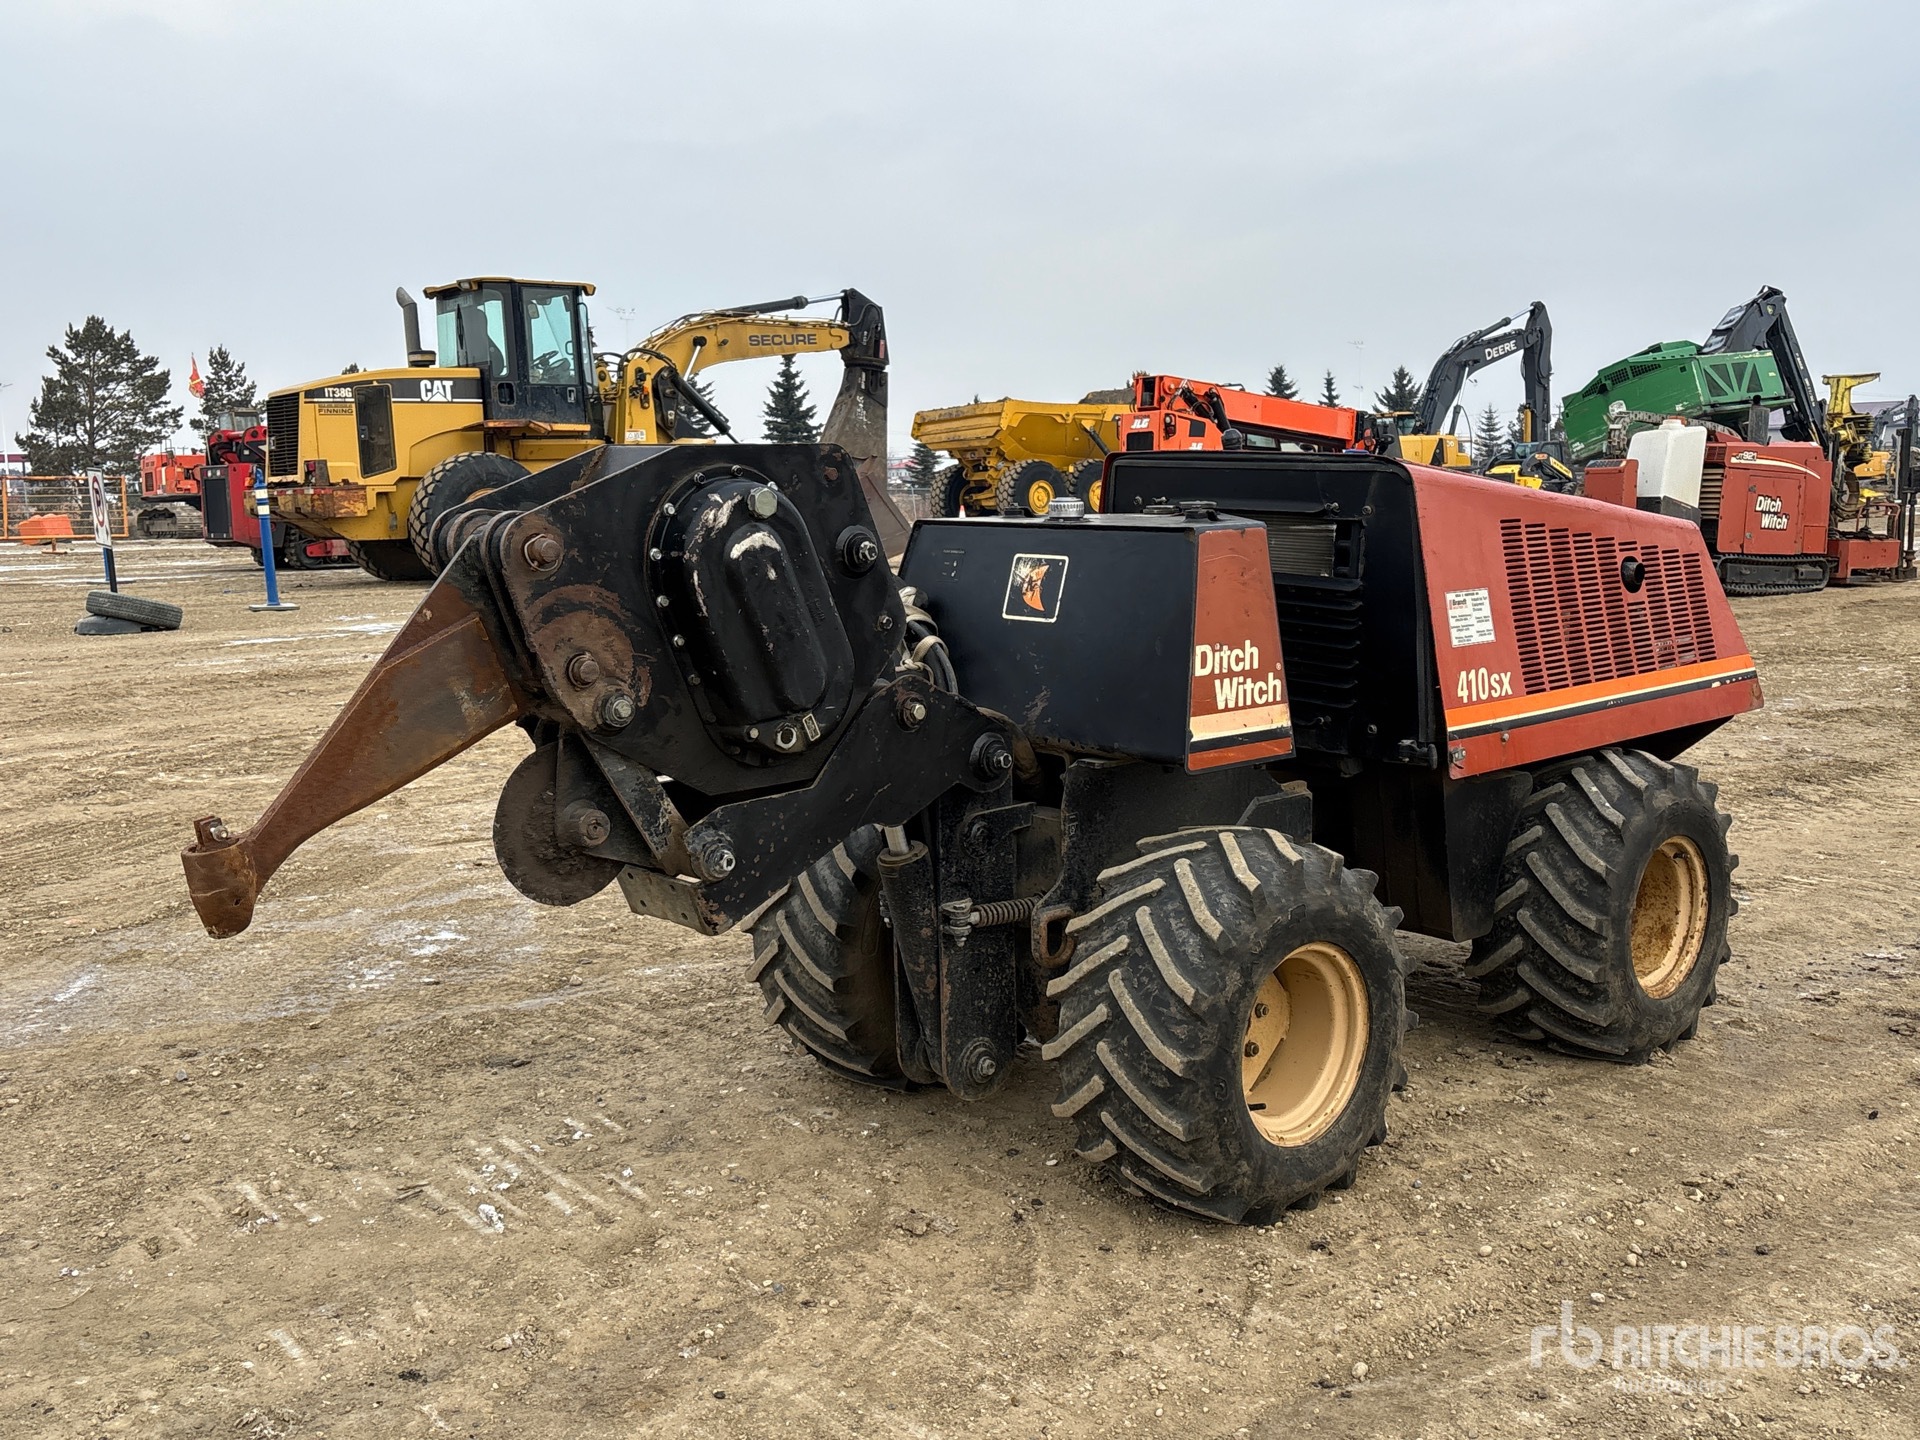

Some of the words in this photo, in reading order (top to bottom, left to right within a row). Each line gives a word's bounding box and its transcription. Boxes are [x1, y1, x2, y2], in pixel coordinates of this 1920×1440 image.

[748, 333, 818, 347] SECURE
[1484, 340, 1518, 361] DEERE
[324, 387, 353, 398] IT38G
[419, 379, 454, 402] CAT
[1130, 418, 1150, 429] JLG
[1755, 496, 1782, 512] Ditch
[1760, 513, 1788, 530] Witch
[1194, 639, 1259, 677] Ditch
[1214, 672, 1282, 710] Witch
